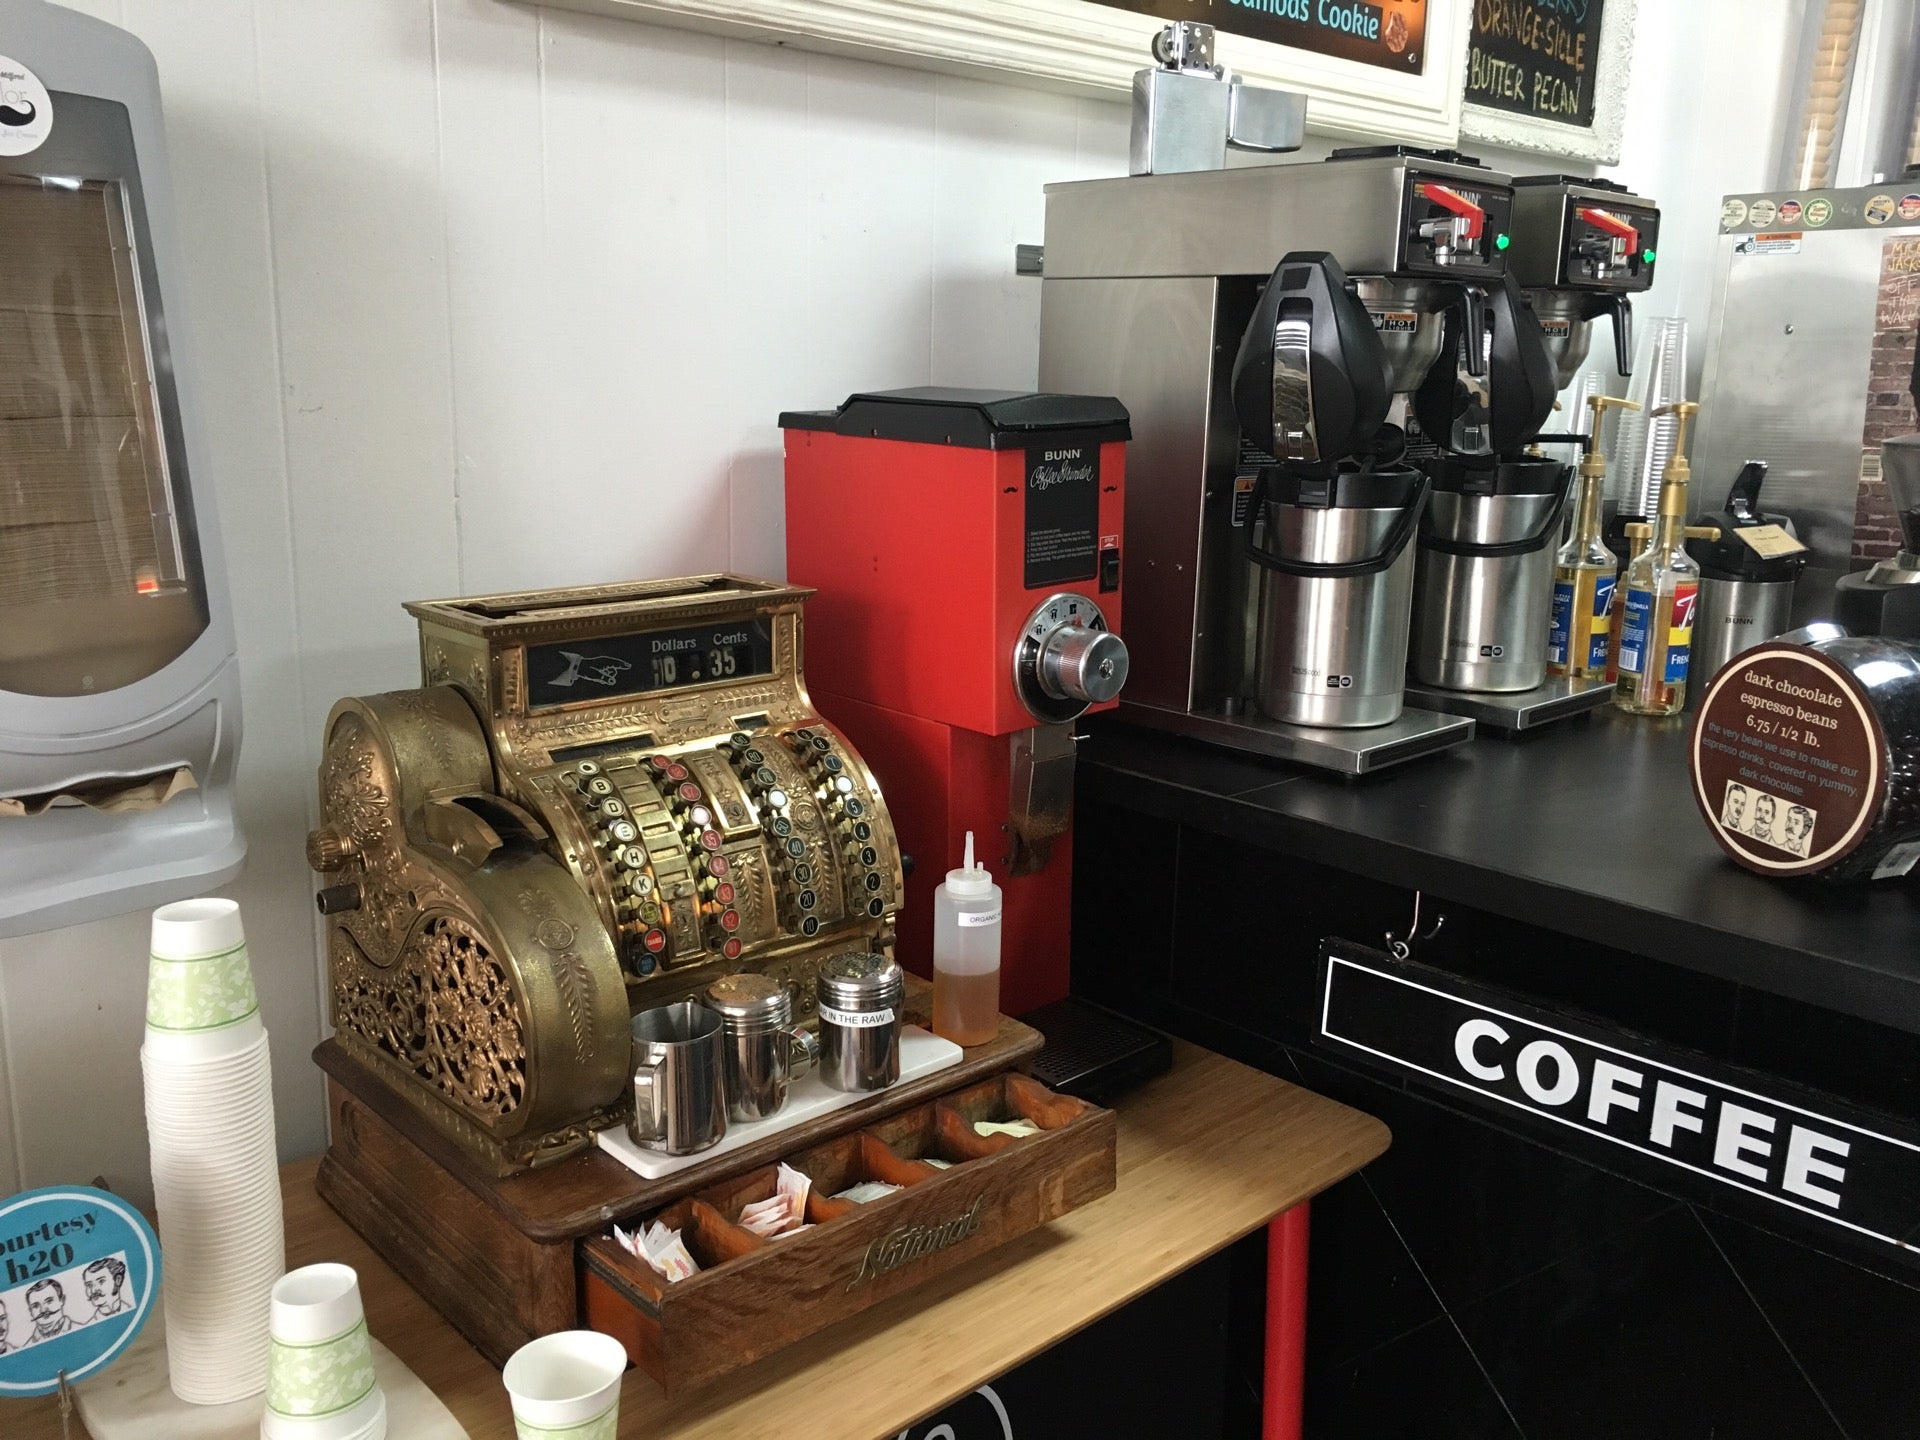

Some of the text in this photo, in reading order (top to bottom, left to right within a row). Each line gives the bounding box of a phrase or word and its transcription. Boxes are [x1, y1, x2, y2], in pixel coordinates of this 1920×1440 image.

[1318, 0, 1379, 40] Cookie
[1470, 47, 1582, 115] BUTTER PECAN
[1044, 449, 1081, 462] BUNN
[1725, 617, 1754, 625] BUNN
[652, 632, 748, 653] Dollars Cents
[711, 647, 736, 677] 35
[1745, 670, 1843, 708] dark chocolate
[1740, 692, 1838, 730] espresso beans
[1746, 714, 1770, 735] 6.75
[1781, 725, 1799, 742] 1/2
[1804, 731, 1821, 748] lb.
[1702, 738, 1738, 756] espresso
[1768, 760, 1806, 780] covered
[1741, 734, 1763, 748] bean
[1779, 746, 1797, 759] use
[1810, 755, 1839, 772] make
[1840, 764, 1859, 777] our
[1739, 766, 1758, 781] dark
[802, 892, 812, 906] 20
[969, 914, 997, 923] ORGANIC
[828, 1012, 837, 1021] IN
[839, 1014, 858, 1025] THE
[861, 1013, 886, 1025] RAW
[1455, 1018, 1851, 1209] COFFEE
